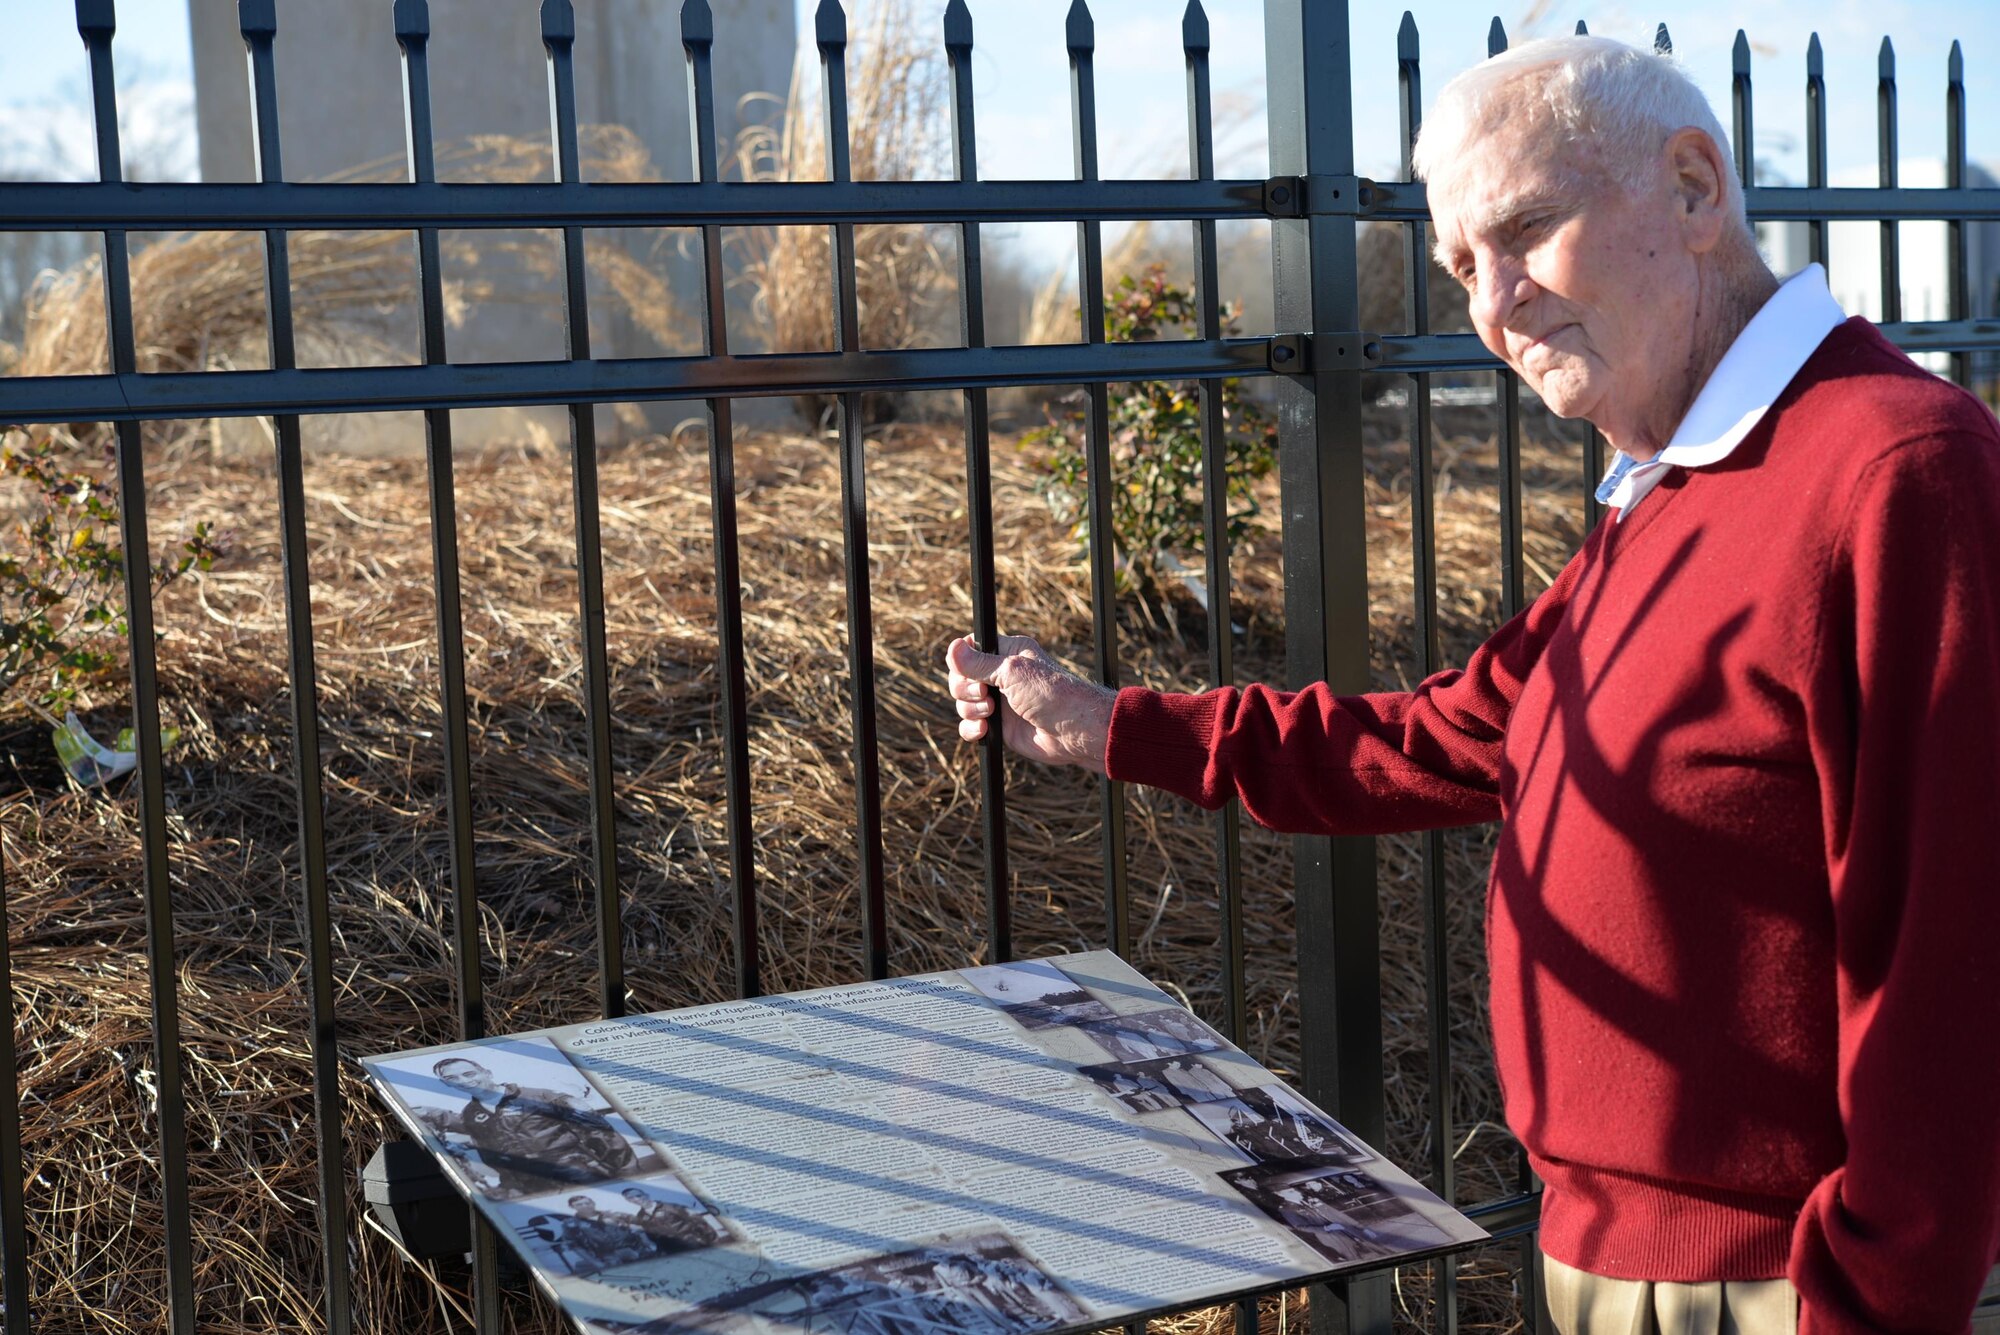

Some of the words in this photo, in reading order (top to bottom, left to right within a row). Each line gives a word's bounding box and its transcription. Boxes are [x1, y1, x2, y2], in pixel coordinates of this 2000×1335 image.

[572, 1038, 585, 1047] of
[586, 1036, 610, 1045] war
[612, 1033, 624, 1041] in
[625, 1026, 679, 1038] Vietnam,
[680, 1017, 735, 1030] including
[736, 1010, 776, 1021] several
[777, 1006, 808, 1017] years
[822, 1001, 842, 1009] the
[842, 993, 895, 1006] infamous
[895, 989, 929, 999] Hanoi
[928, 983, 967, 995] Hilton.
[585, 1023, 631, 1036] Colonel
[631, 1016, 671, 1028] Smitty
[672, 1012, 708, 1023] Harris
[709, 1008, 721, 1017] of
[723, 1003, 762, 1016] Tupelo
[764, 998, 797, 1009] spent
[798, 992, 833, 1003] nearly
[842, 988, 873, 998] years
[896, 978, 942, 990] prisoner
